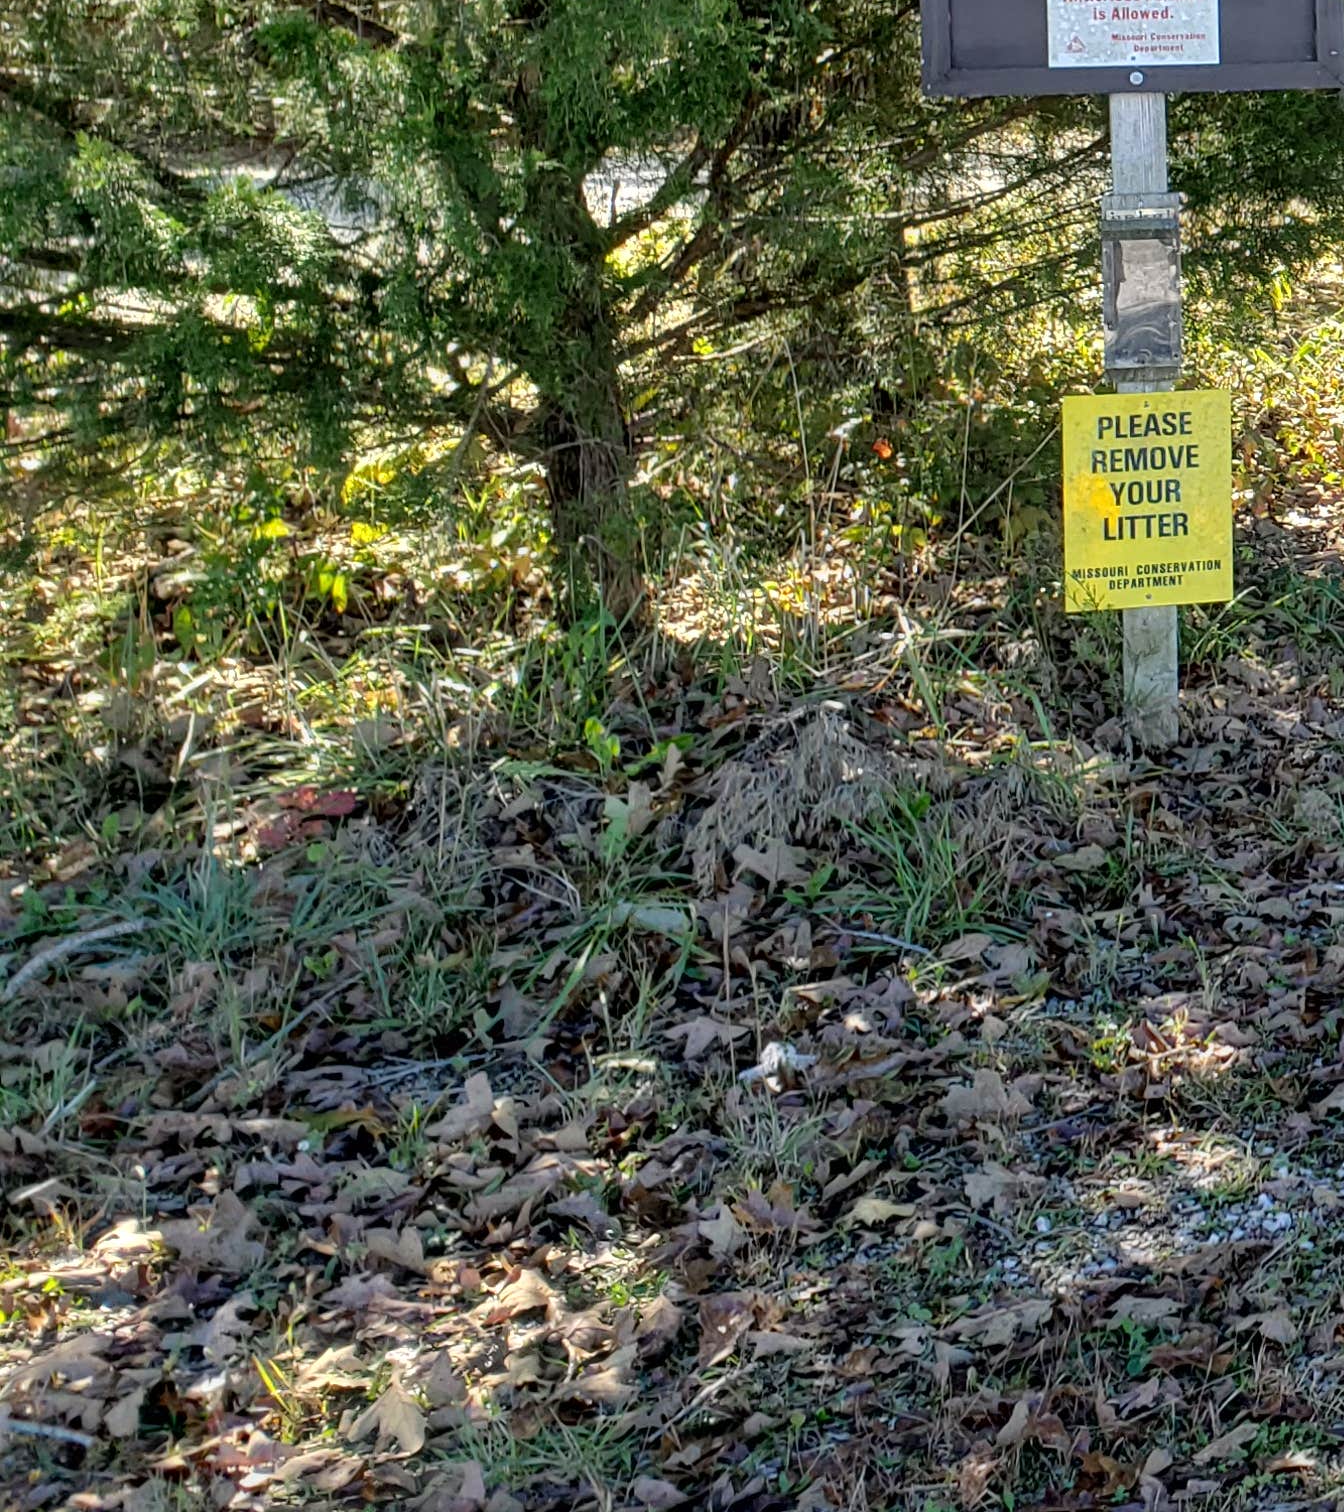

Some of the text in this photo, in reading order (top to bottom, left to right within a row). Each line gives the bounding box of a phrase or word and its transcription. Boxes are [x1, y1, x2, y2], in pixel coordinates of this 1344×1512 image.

[1093, 7, 1174, 20] is Allowed.
[1133, 44, 1184, 53] Department
[1097, 411, 1192, 439] PLEASE
[1091, 445, 1199, 473] REMOVE
[1109, 479, 1180, 506] YOUR
[1104, 513, 1189, 541] LITTER
[1072, 560, 1221, 579] MISSOURI CONSERVATION
[1109, 575, 1184, 590] DEPARTMENT
